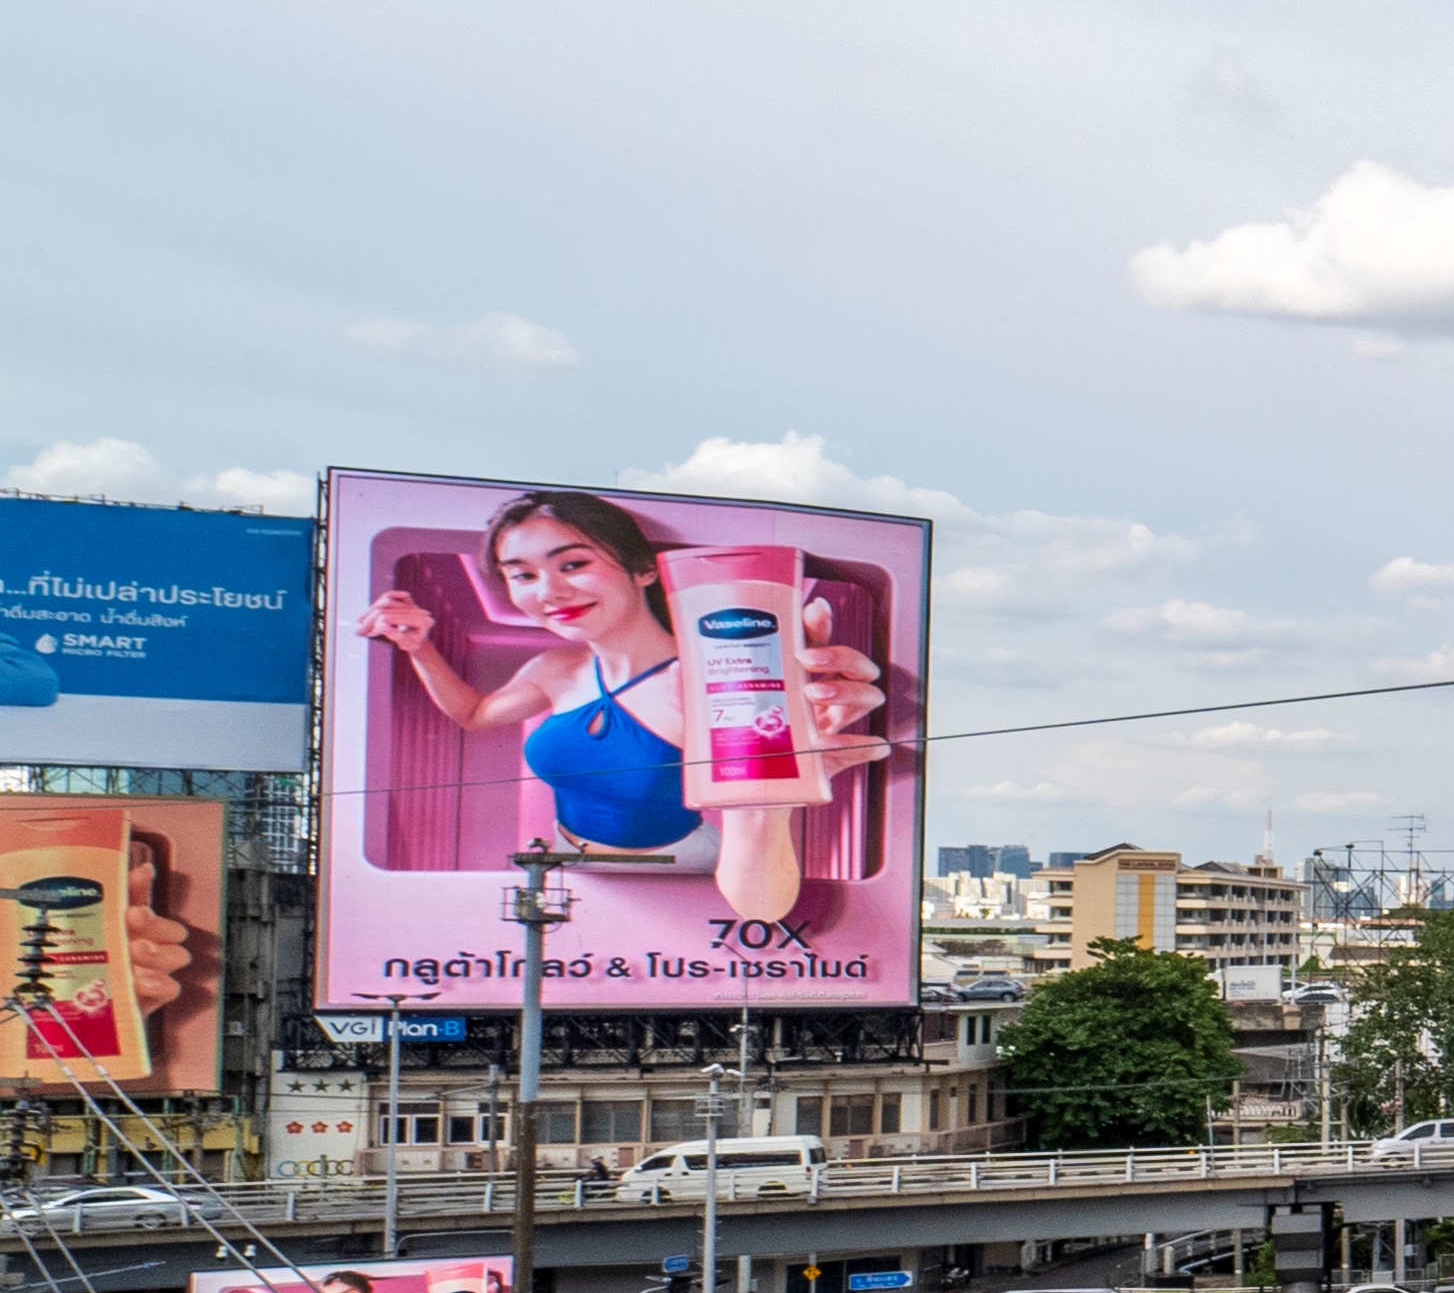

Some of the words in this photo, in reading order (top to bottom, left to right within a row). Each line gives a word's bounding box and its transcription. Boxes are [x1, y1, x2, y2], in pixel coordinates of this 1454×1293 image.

[0, 570, 287, 610] ...ที่ไม่เปล่าประโยชน์
[703, 617, 772, 630] Vaseline
[63, 633, 147, 650] SMART
[62, 649, 101, 657] MICRO
[106, 650, 147, 658] FILTER
[725, 657, 752, 665] Extra
[708, 666, 770, 676] Brightening
[708, 918, 812, 949] 70X
[605, 957, 633, 978] &
